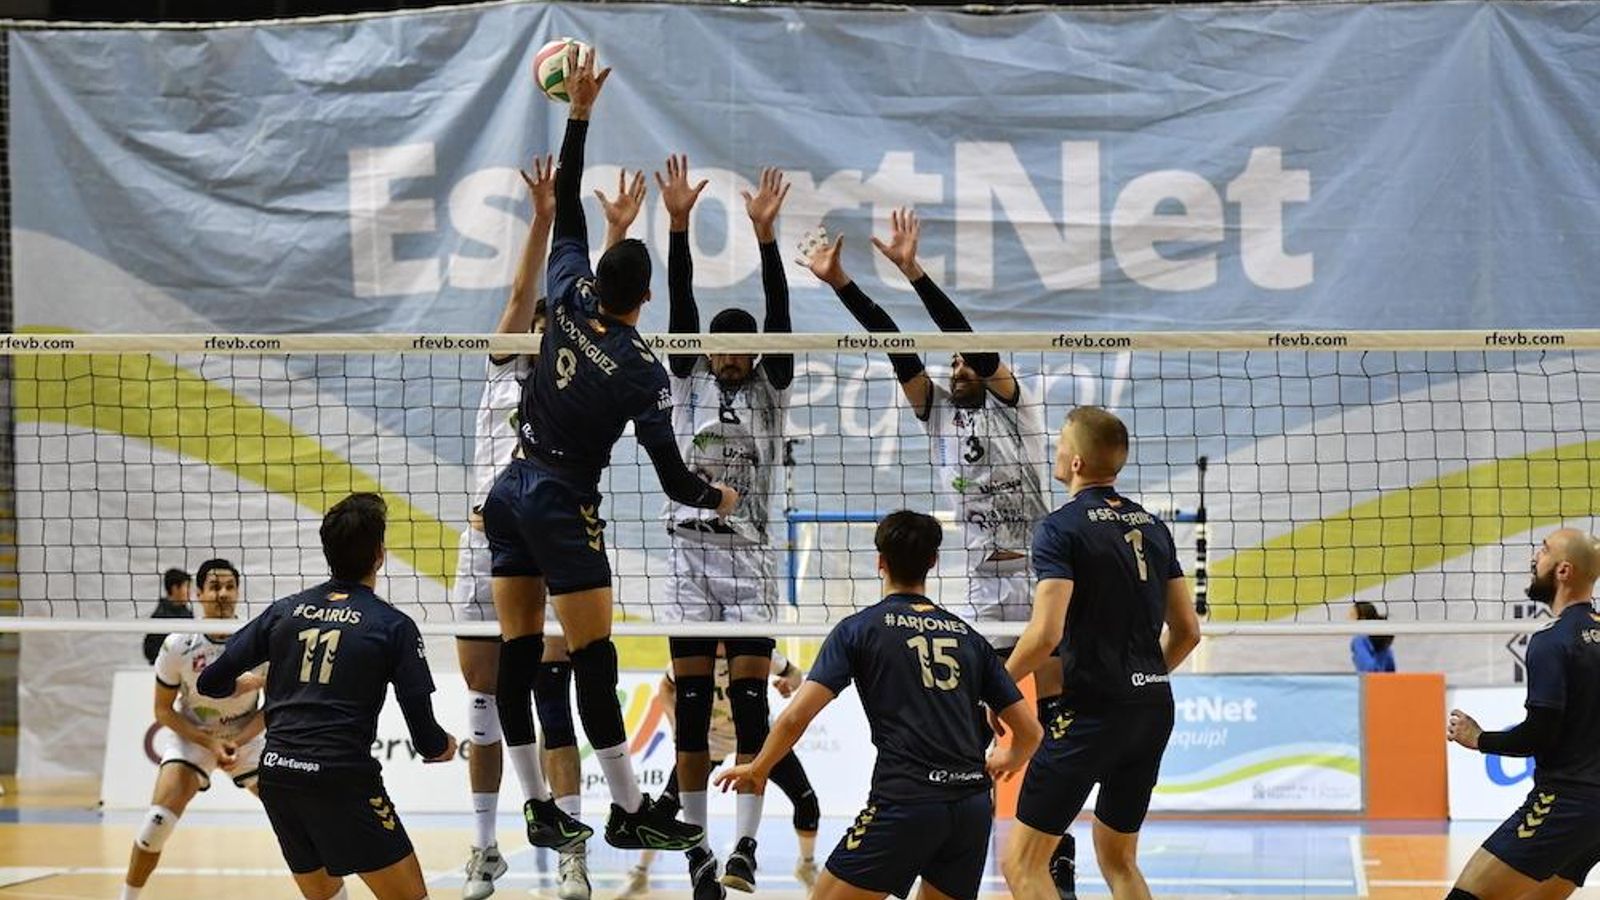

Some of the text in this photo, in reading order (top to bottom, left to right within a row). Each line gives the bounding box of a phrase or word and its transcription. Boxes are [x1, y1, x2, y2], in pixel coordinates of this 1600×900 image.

[0, 337, 75, 350] rfevb.com
[204, 337, 281, 350] rfevb.com
[412, 335, 490, 349] rfevb.com
[645, 335, 701, 349] vb.com
[836, 335, 916, 349] rfevb.com
[1051, 333, 1131, 348] rfevb.com
[1267, 333, 1348, 347] rfevb.com
[1484, 331, 1565, 346] rfevb.com
[963, 435, 985, 464] 3
[1124, 528, 1148, 581] 1
[292, 603, 362, 624] #CAIRÚS
[884, 612, 969, 635] #ARJONES
[299, 627, 341, 684] 11
[906, 635, 961, 691] 15
